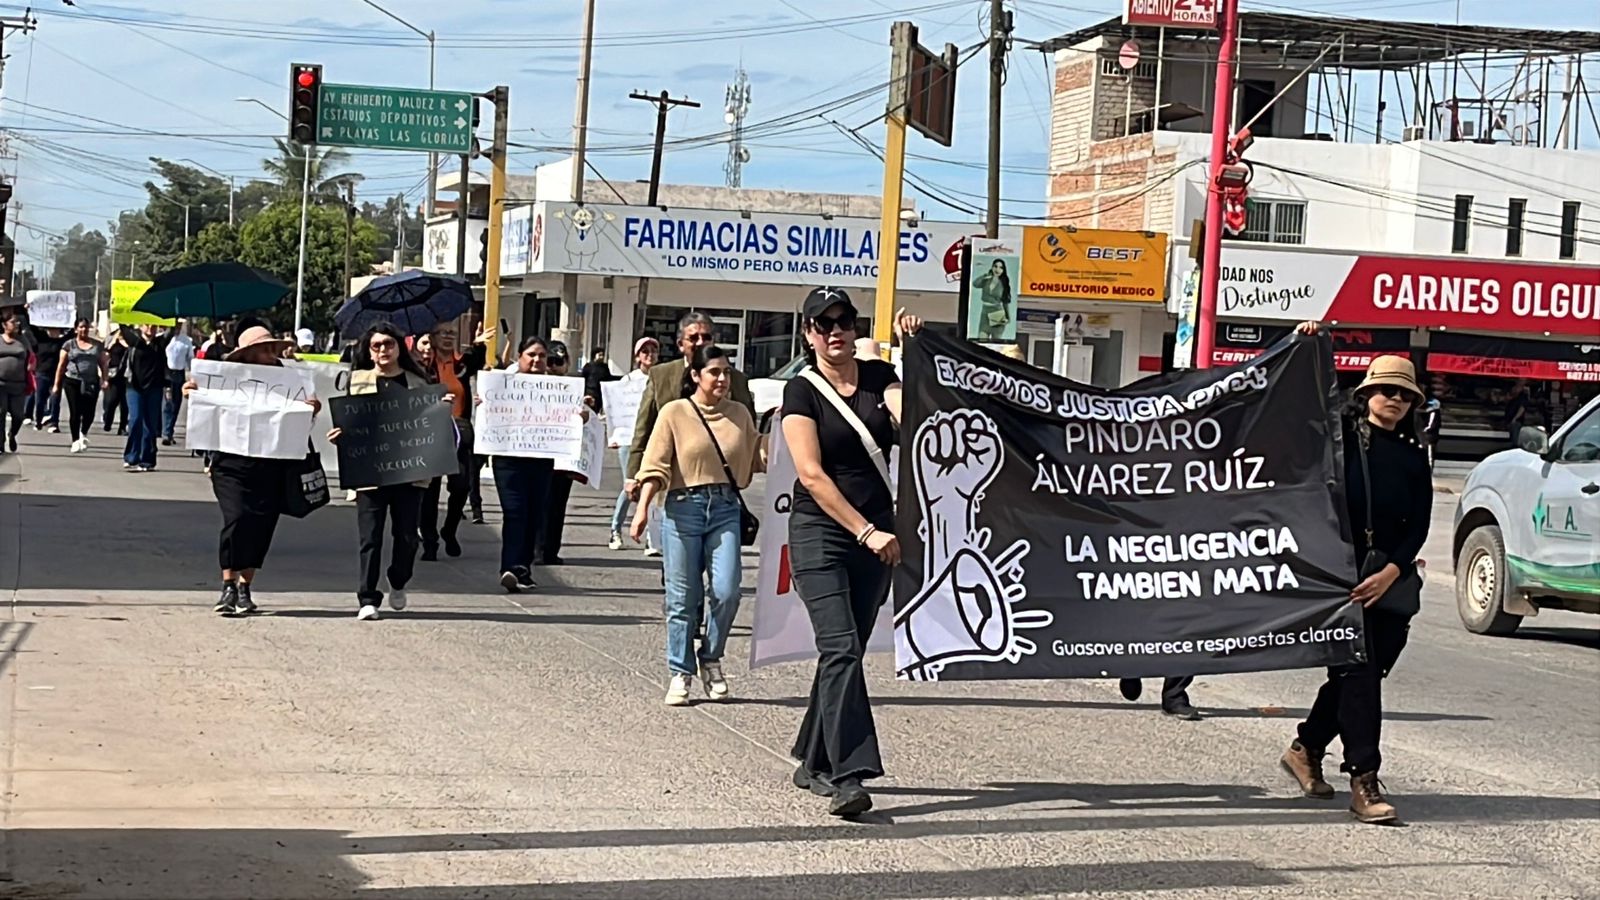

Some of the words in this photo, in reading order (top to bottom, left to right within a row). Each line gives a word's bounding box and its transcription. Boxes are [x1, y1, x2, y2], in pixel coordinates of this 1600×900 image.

[1173, 11, 1213, 22] HORAS
[341, 93, 392, 108] HERIBERTO
[399, 96, 434, 111] VALDEZ
[323, 108, 371, 123] ESTADIOS
[380, 111, 446, 128] DEPORTIVOS
[339, 126, 380, 141] PLAYAS
[390, 130, 410, 143] LAS
[420, 131, 467, 146] GLORIAS
[624, 217, 778, 255] FARMACIAS
[786, 224, 928, 263] SIMILAES
[1086, 246, 1143, 261] BEST
[691, 256, 739, 270] MISMO
[743, 259, 784, 272] PERO
[787, 260, 819, 274] MAS
[1219, 266, 1246, 282] DAD
[1249, 268, 1274, 284] NOS
[1029, 281, 1109, 295] CONSULTORIO
[1112, 284, 1155, 297] MEDICO
[1221, 284, 1315, 311] Distingue
[1372, 273, 1500, 315] CARNES
[933, 354, 1052, 413] EXIGIMOS
[1057, 389, 1184, 423] JUSTICIA
[1065, 417, 1222, 454] PINDARO
[1031, 453, 1176, 495] ÁLVAREZ
[1184, 447, 1276, 493] RUÍZ.
[1065, 534, 1098, 563] LA
[1108, 527, 1299, 564] NEGLIGENCIA
[1077, 569, 1201, 601] TAMBIEN
[1213, 563, 1299, 597] MATA
[1052, 639, 1123, 657] Guasave
[1128, 640, 1193, 655] merece
[1197, 630, 1296, 655] respuestas
[1299, 626, 1359, 644] claras.
